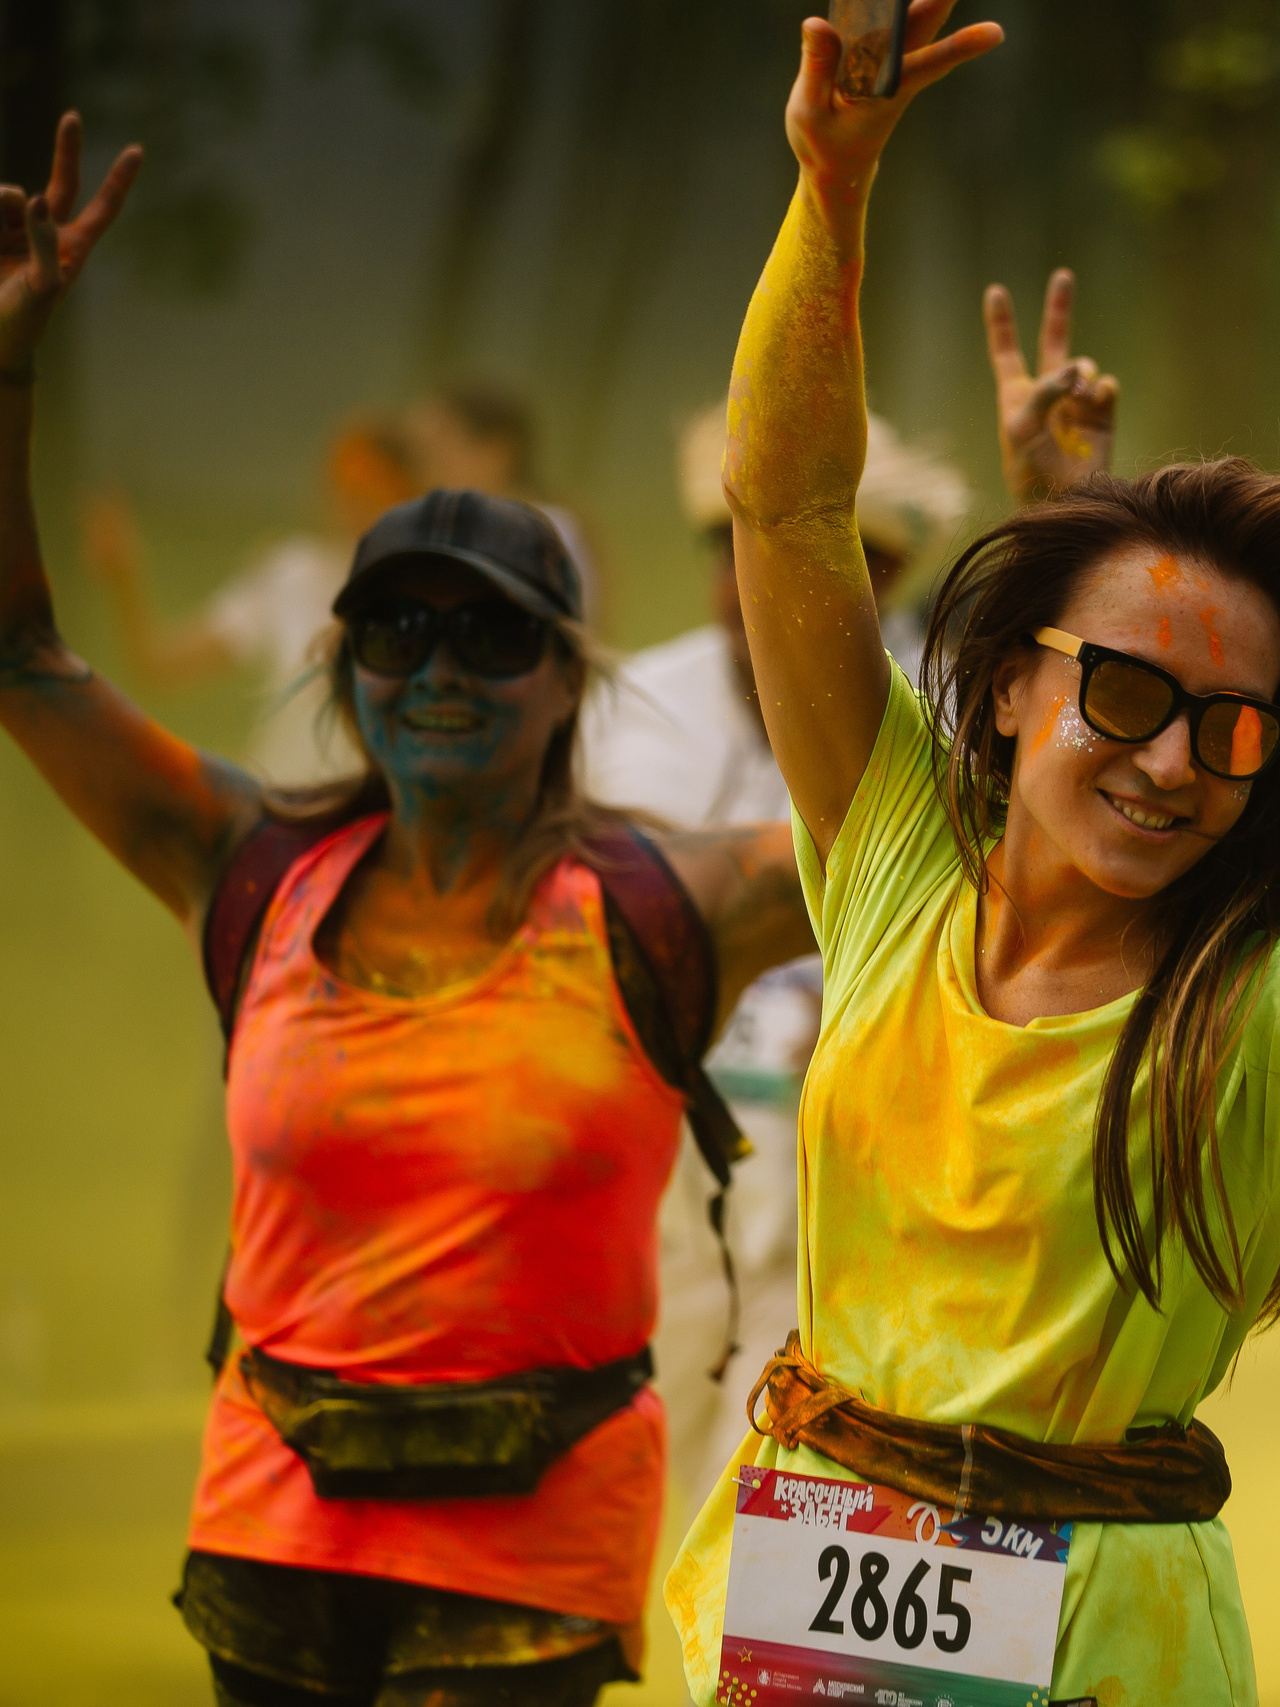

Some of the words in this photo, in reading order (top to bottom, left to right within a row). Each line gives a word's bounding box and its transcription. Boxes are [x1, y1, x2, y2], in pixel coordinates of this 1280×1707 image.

[773, 1476, 874, 1512] КРАСОЧНЫЙ
[790, 1498, 855, 1531] ЗАБЕГ
[808, 1544, 972, 1653] 2865
[874, 1689, 898, 1707] 100
